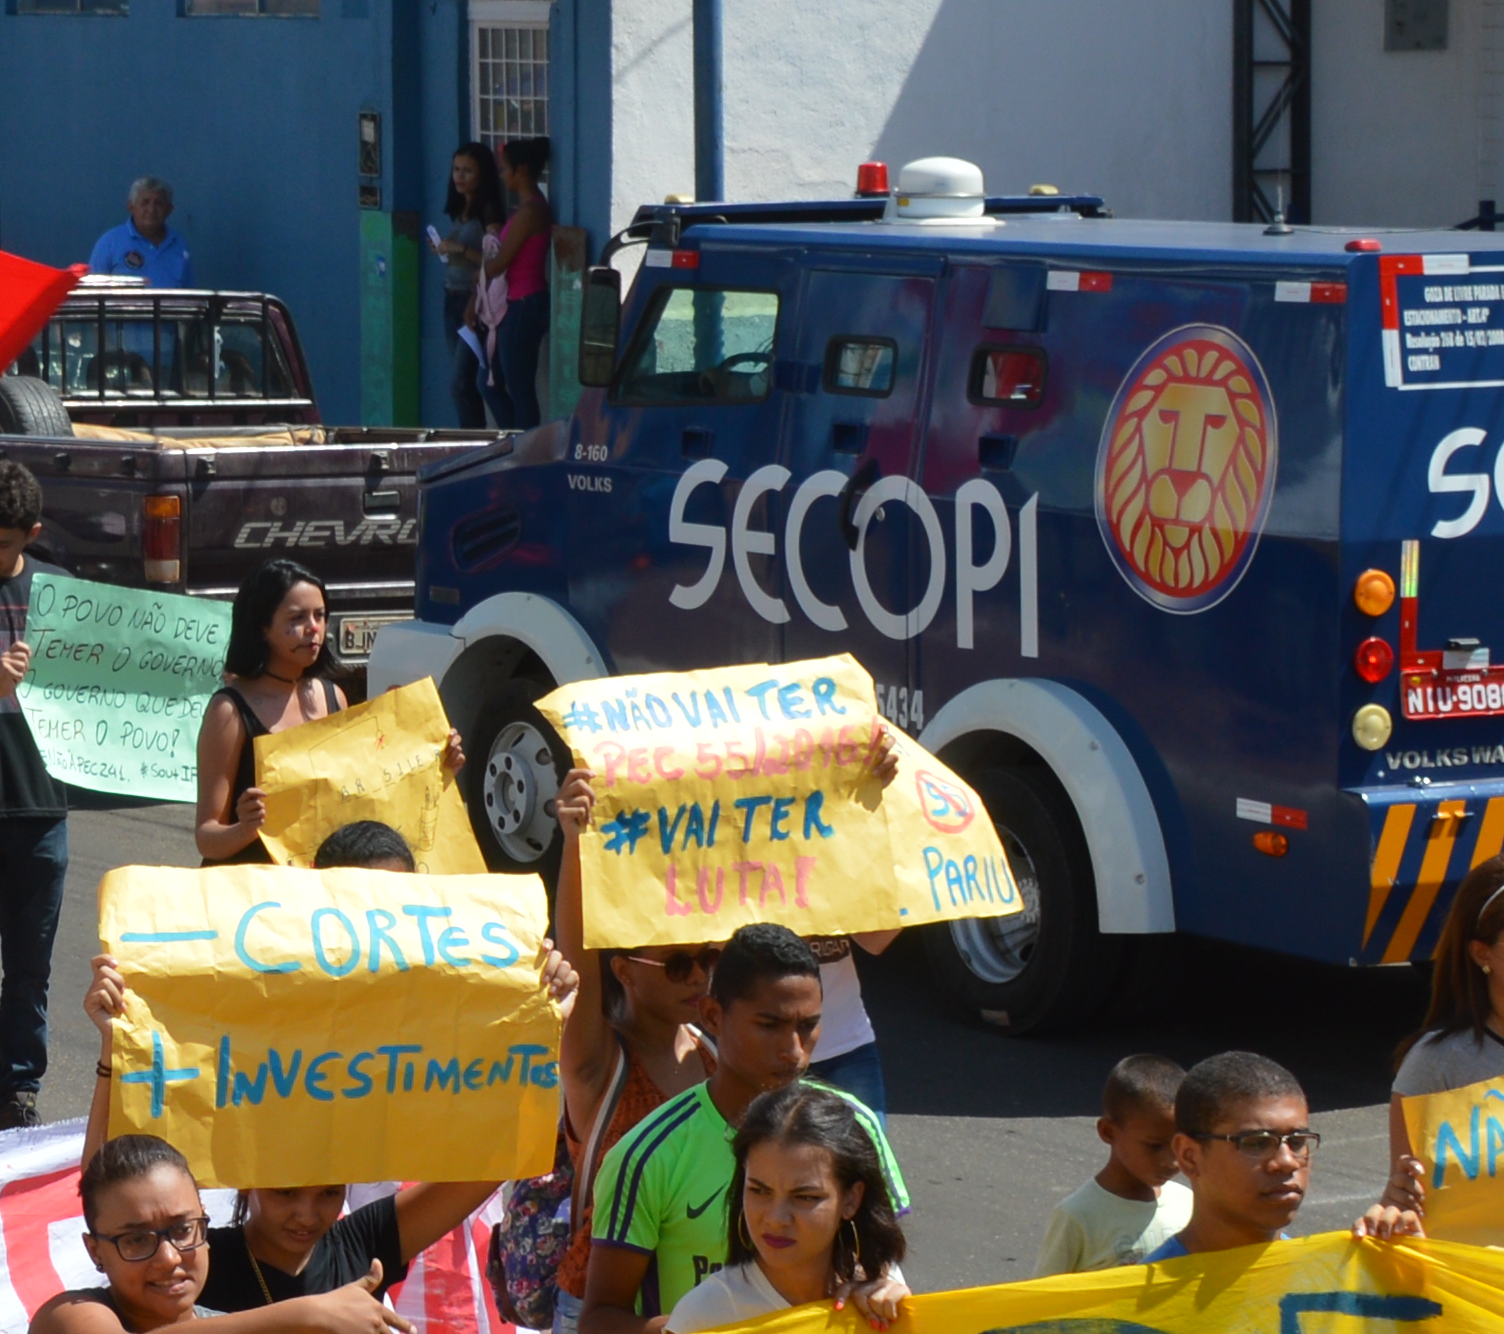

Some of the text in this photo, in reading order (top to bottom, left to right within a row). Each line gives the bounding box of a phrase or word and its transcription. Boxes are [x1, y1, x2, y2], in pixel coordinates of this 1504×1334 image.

[1473, 284, 1500, 300] PARADA
[1403, 308, 1462, 326] ESTACIONAMENTO
[574, 444, 608, 463] 8-160
[567, 473, 613, 493] VOLKS
[667, 457, 1040, 659] SECOPI
[36, 582, 220, 645] O POVO NÃO DEVE
[31, 628, 105, 666] TEMER
[111, 646, 132, 672] O
[42, 681, 127, 709] GOVERNO
[745, 676, 846, 720] TER
[25, 707, 181, 759] TEMER O POVO!
[592, 740, 685, 787] PEC
[735, 789, 834, 846] TER
[664, 856, 817, 916] LUTA!
[922, 845, 1015, 912] PARIU
[234, 900, 521, 978] CORTES
[215, 1031, 561, 1109] INVESTIMENTOS
